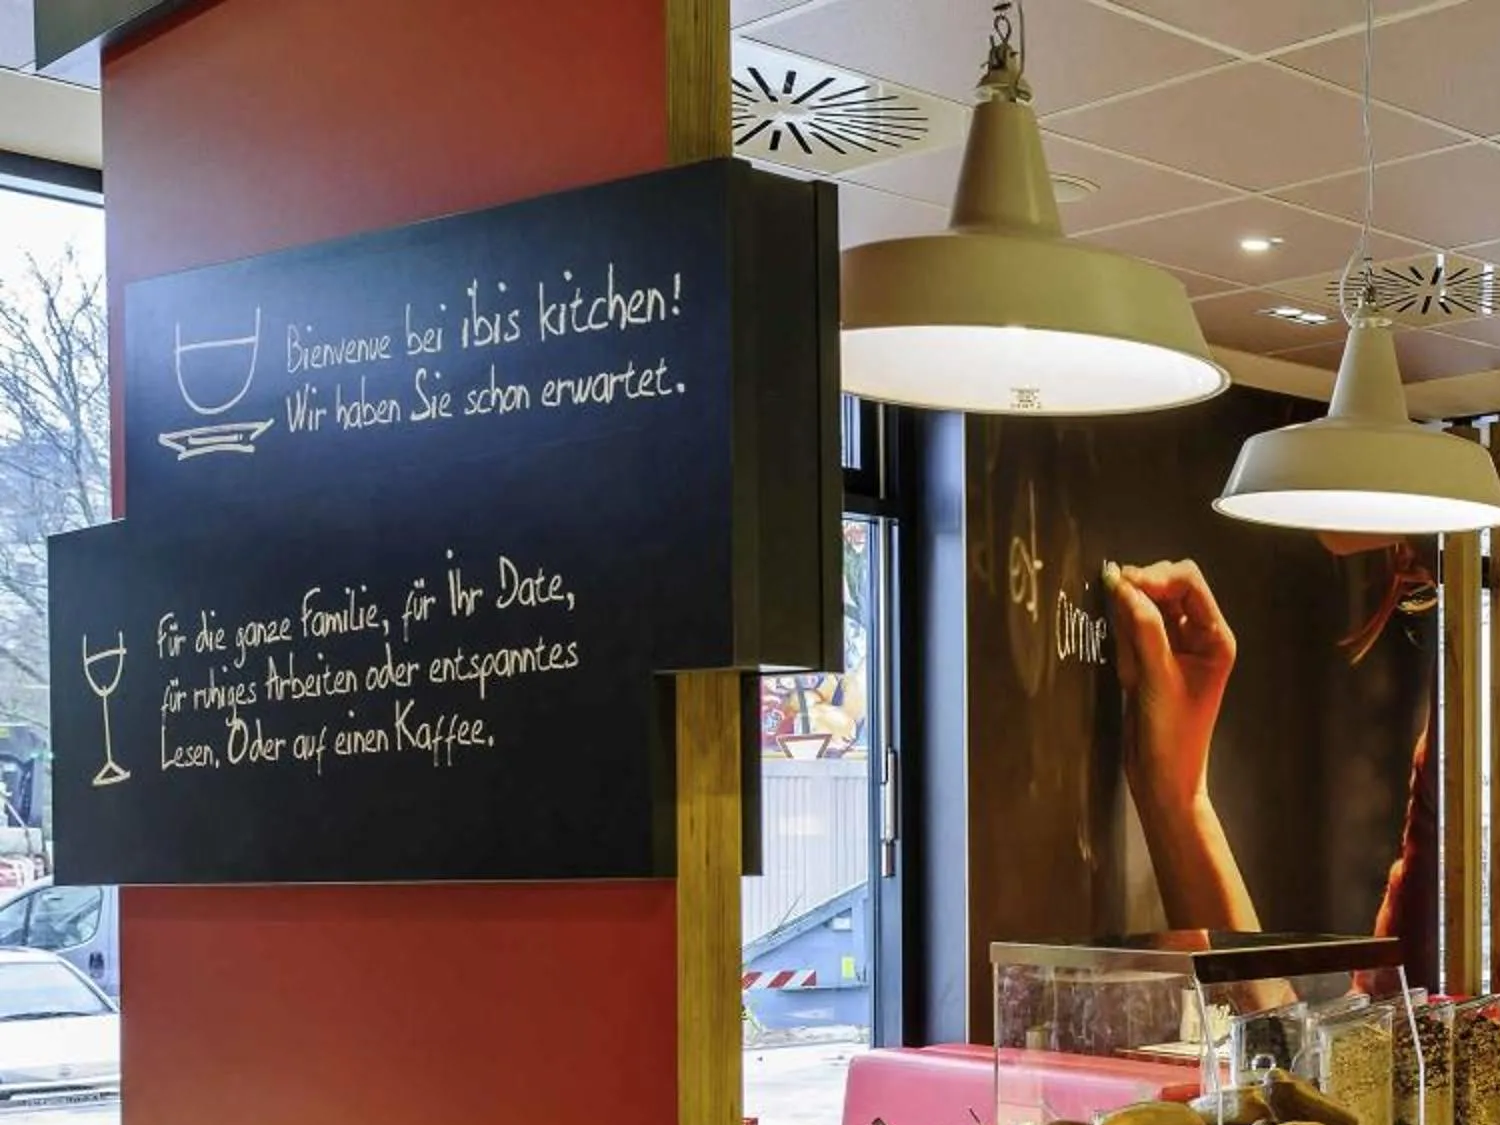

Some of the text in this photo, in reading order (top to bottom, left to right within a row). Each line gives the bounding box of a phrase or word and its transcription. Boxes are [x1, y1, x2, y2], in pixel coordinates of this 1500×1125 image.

[287, 262, 681, 373] Bienvenue bei ibis kitchen!
[286, 357, 686, 433] Wir haben Sie schon erwartet.
[195, 610, 227, 653] die
[234, 617, 292, 669] ganze
[401, 578, 436, 642] für
[446, 549, 484, 617] Ihr
[496, 556, 575, 611] Date,
[160, 636, 579, 727] für ruhiges Arbeiten oder entspanntes
[227, 718, 286, 763] Oder
[293, 726, 327, 776] auf
[334, 710, 389, 755] einen
[394, 699, 494, 767] Kaffee.
